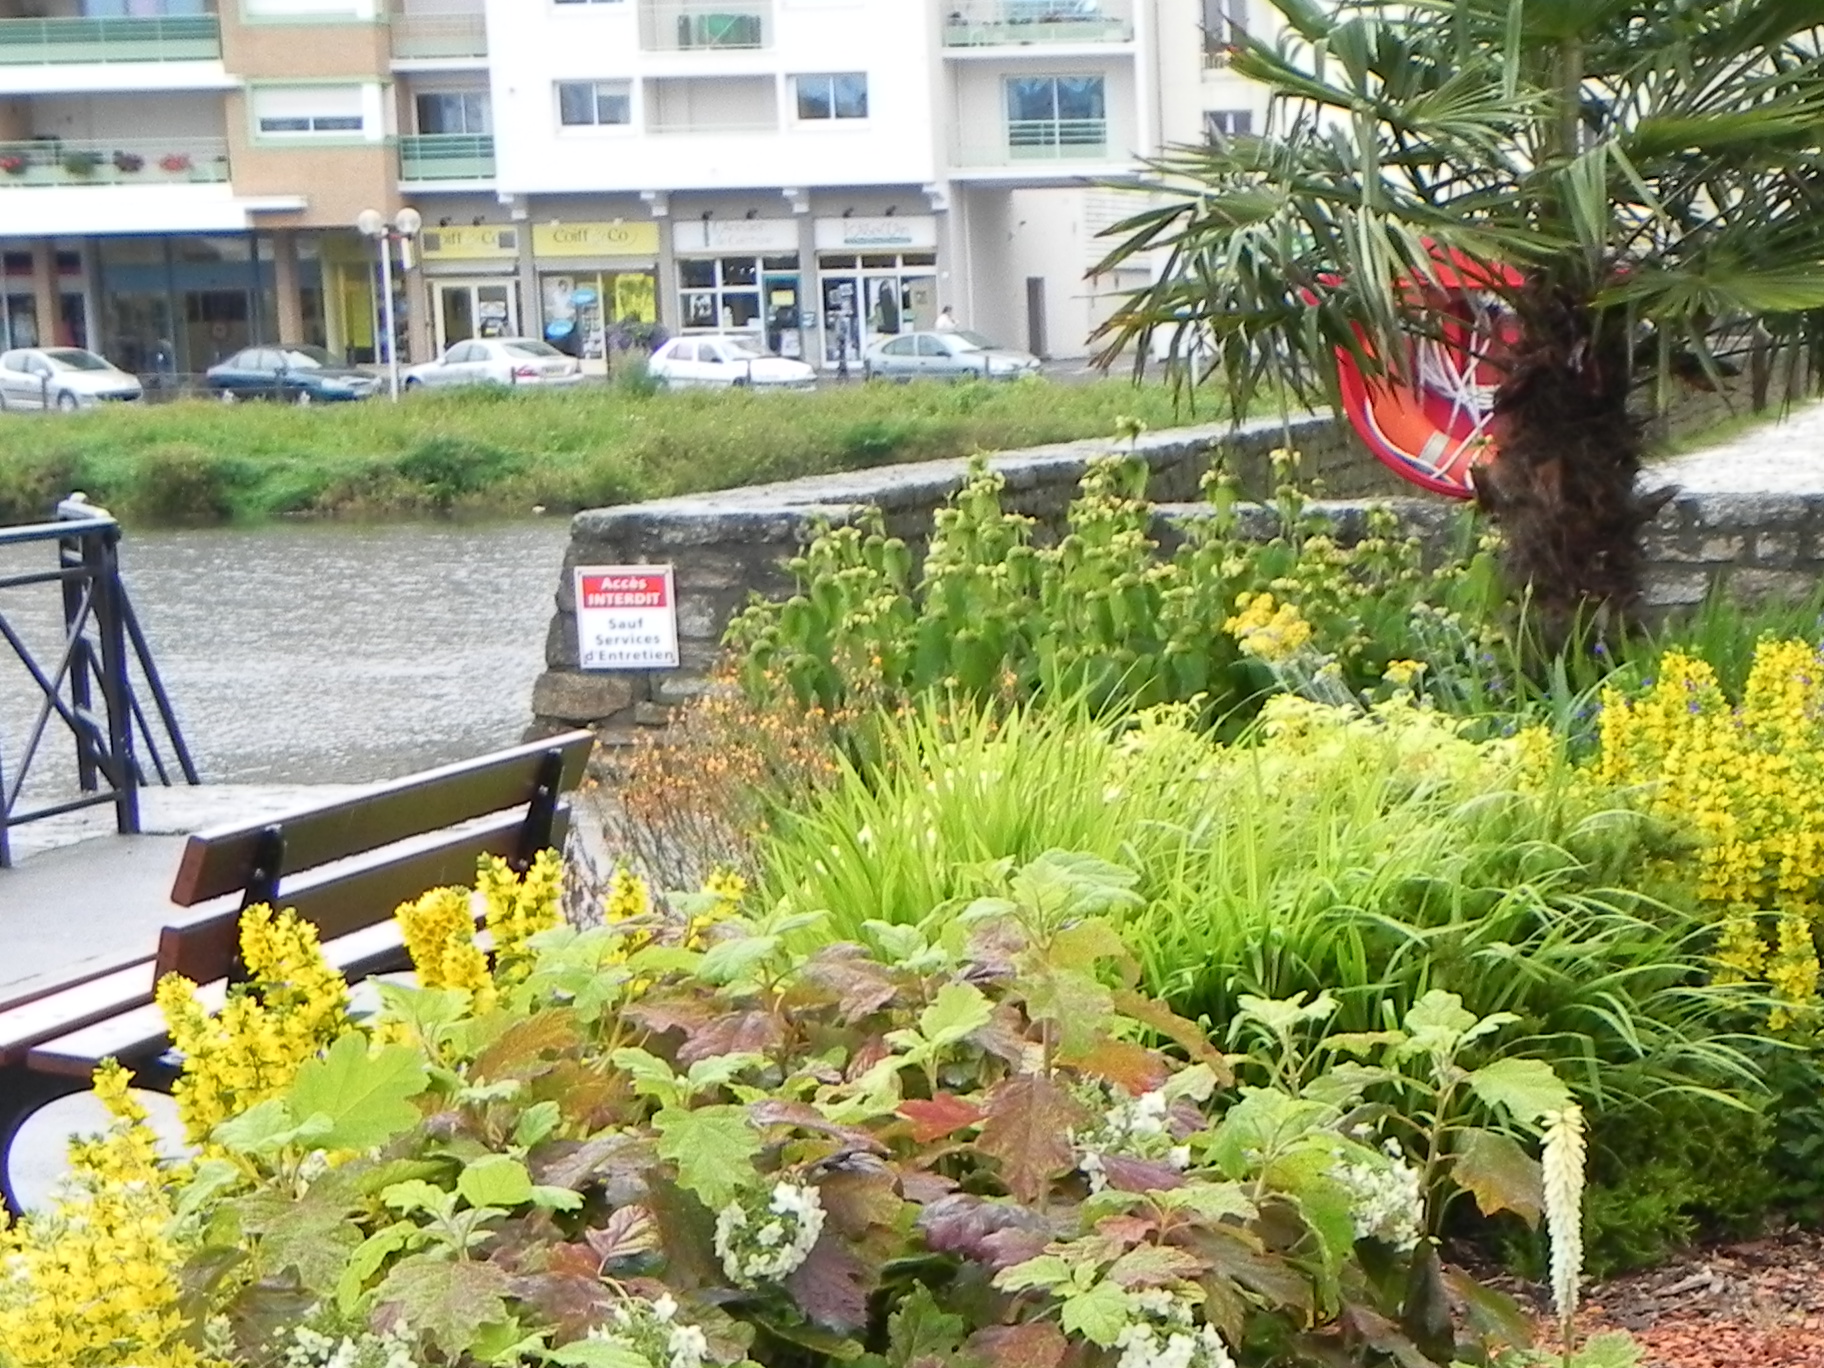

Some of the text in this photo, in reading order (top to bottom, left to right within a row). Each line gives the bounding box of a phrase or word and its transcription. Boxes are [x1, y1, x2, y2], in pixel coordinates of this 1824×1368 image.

[607, 228, 629, 242] Co
[601, 576, 648, 590] Accès
[588, 592, 661, 606] INTERDIT
[608, 617, 644, 630] Sauf
[595, 634, 661, 646] Services
[585, 650, 674, 662] d'Entretien
